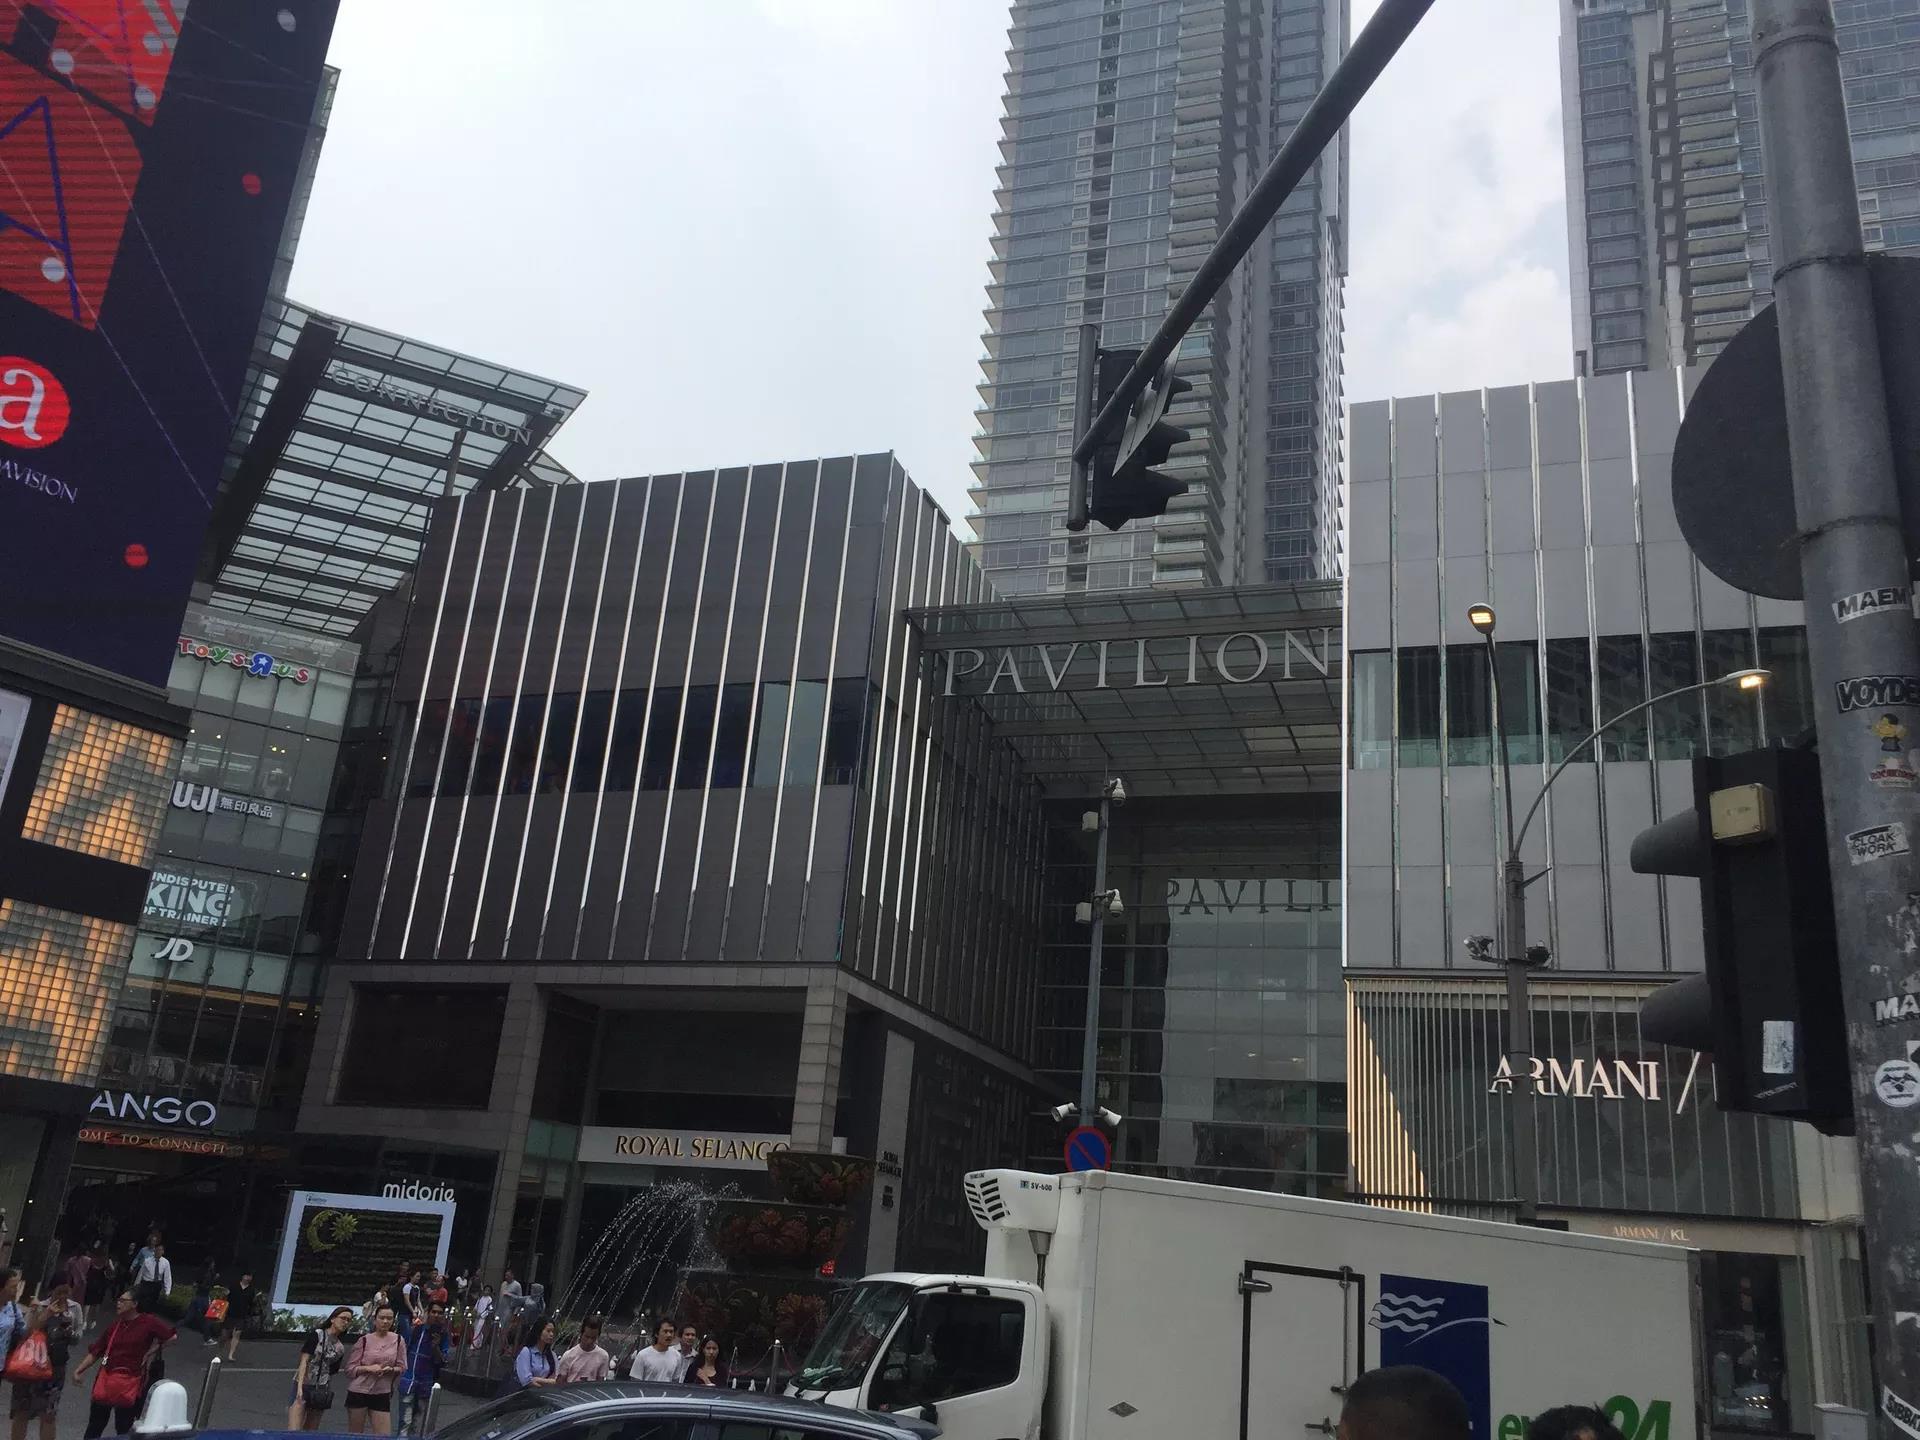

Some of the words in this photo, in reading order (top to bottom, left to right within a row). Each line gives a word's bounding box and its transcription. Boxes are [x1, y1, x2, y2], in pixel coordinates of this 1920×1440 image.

[332, 368, 534, 446] CONNECTION
[0, 459, 78, 503] AVISION
[942, 626, 1334, 697] PAVILION
[168, 780, 220, 814] UJI
[220, 796, 273, 818] 無印良品
[151, 871, 236, 894] INDISPUTED
[145, 881, 232, 917] KING
[158, 908, 227, 928] TRAINERS
[154, 937, 194, 961] JD
[1488, 1054, 1661, 1101] ARMANI
[121, 1132, 141, 1144] TO
[615, 1135, 684, 1157] ROYAL
[382, 1178, 455, 1202] midorie
[1613, 1226, 1660, 1239] ARMANI
